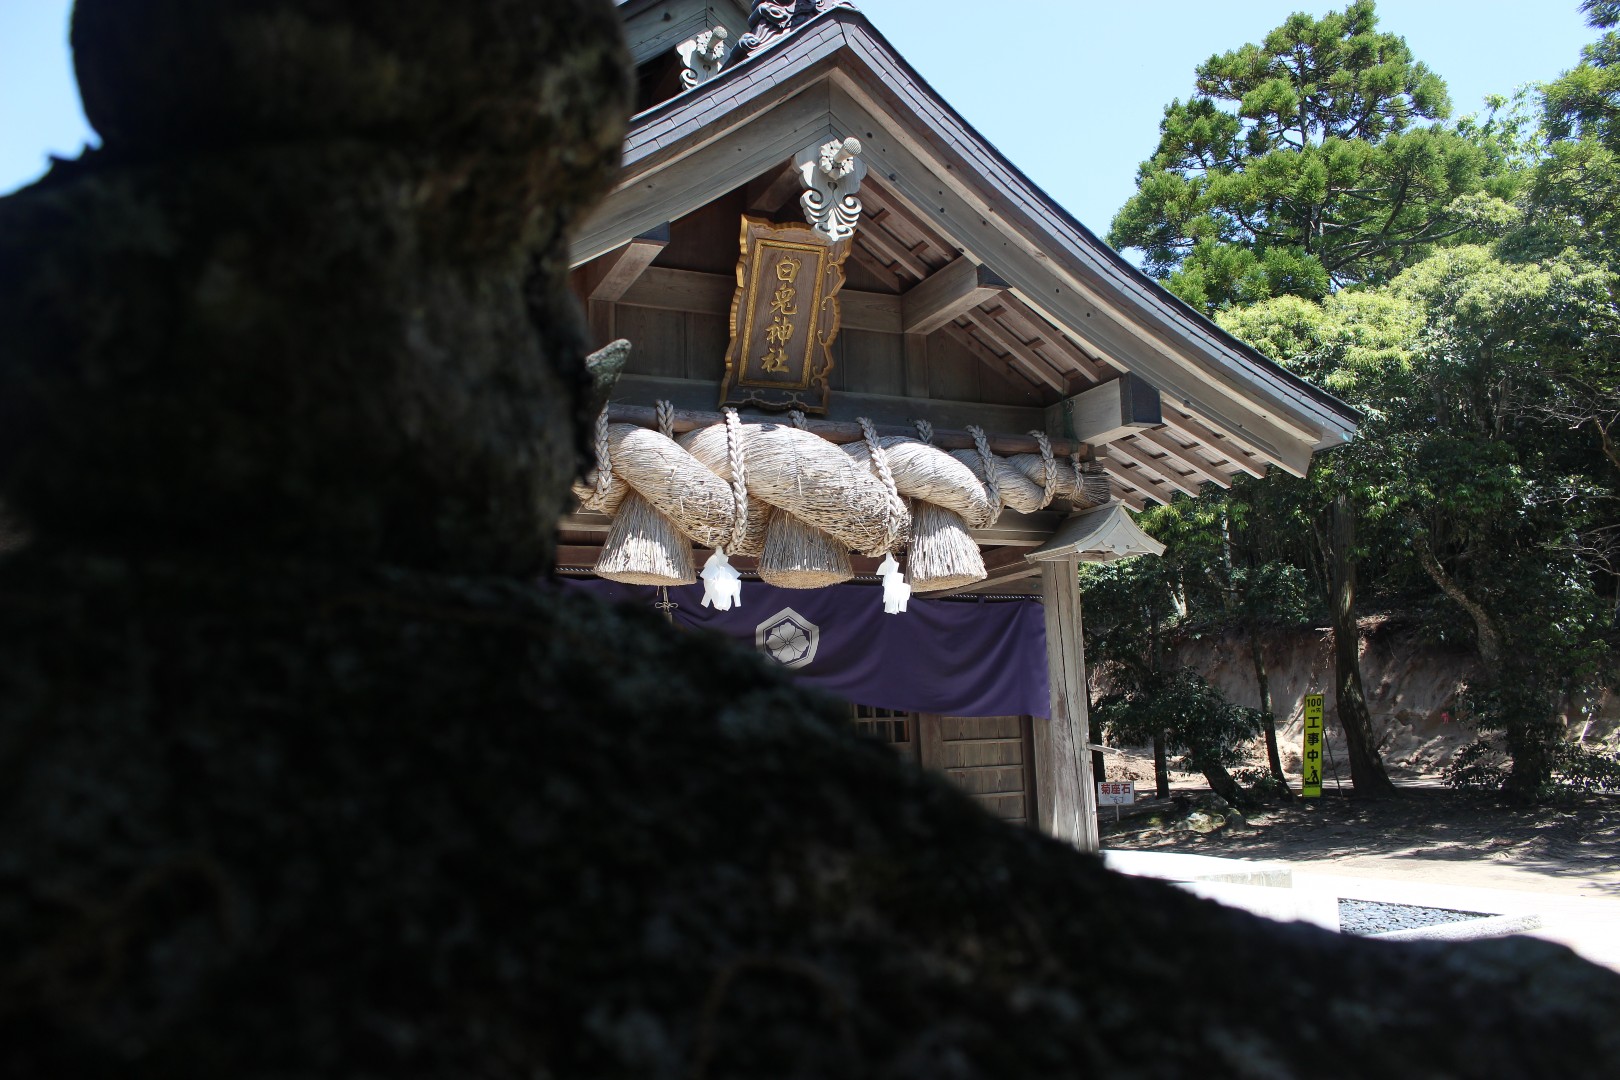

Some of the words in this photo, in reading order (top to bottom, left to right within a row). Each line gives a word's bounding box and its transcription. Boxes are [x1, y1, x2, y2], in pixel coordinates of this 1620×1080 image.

[1307, 698, 1322, 708] 100
[1307, 716, 1320, 762] 工事中
[1101, 783, 1131, 795] 菊座石
